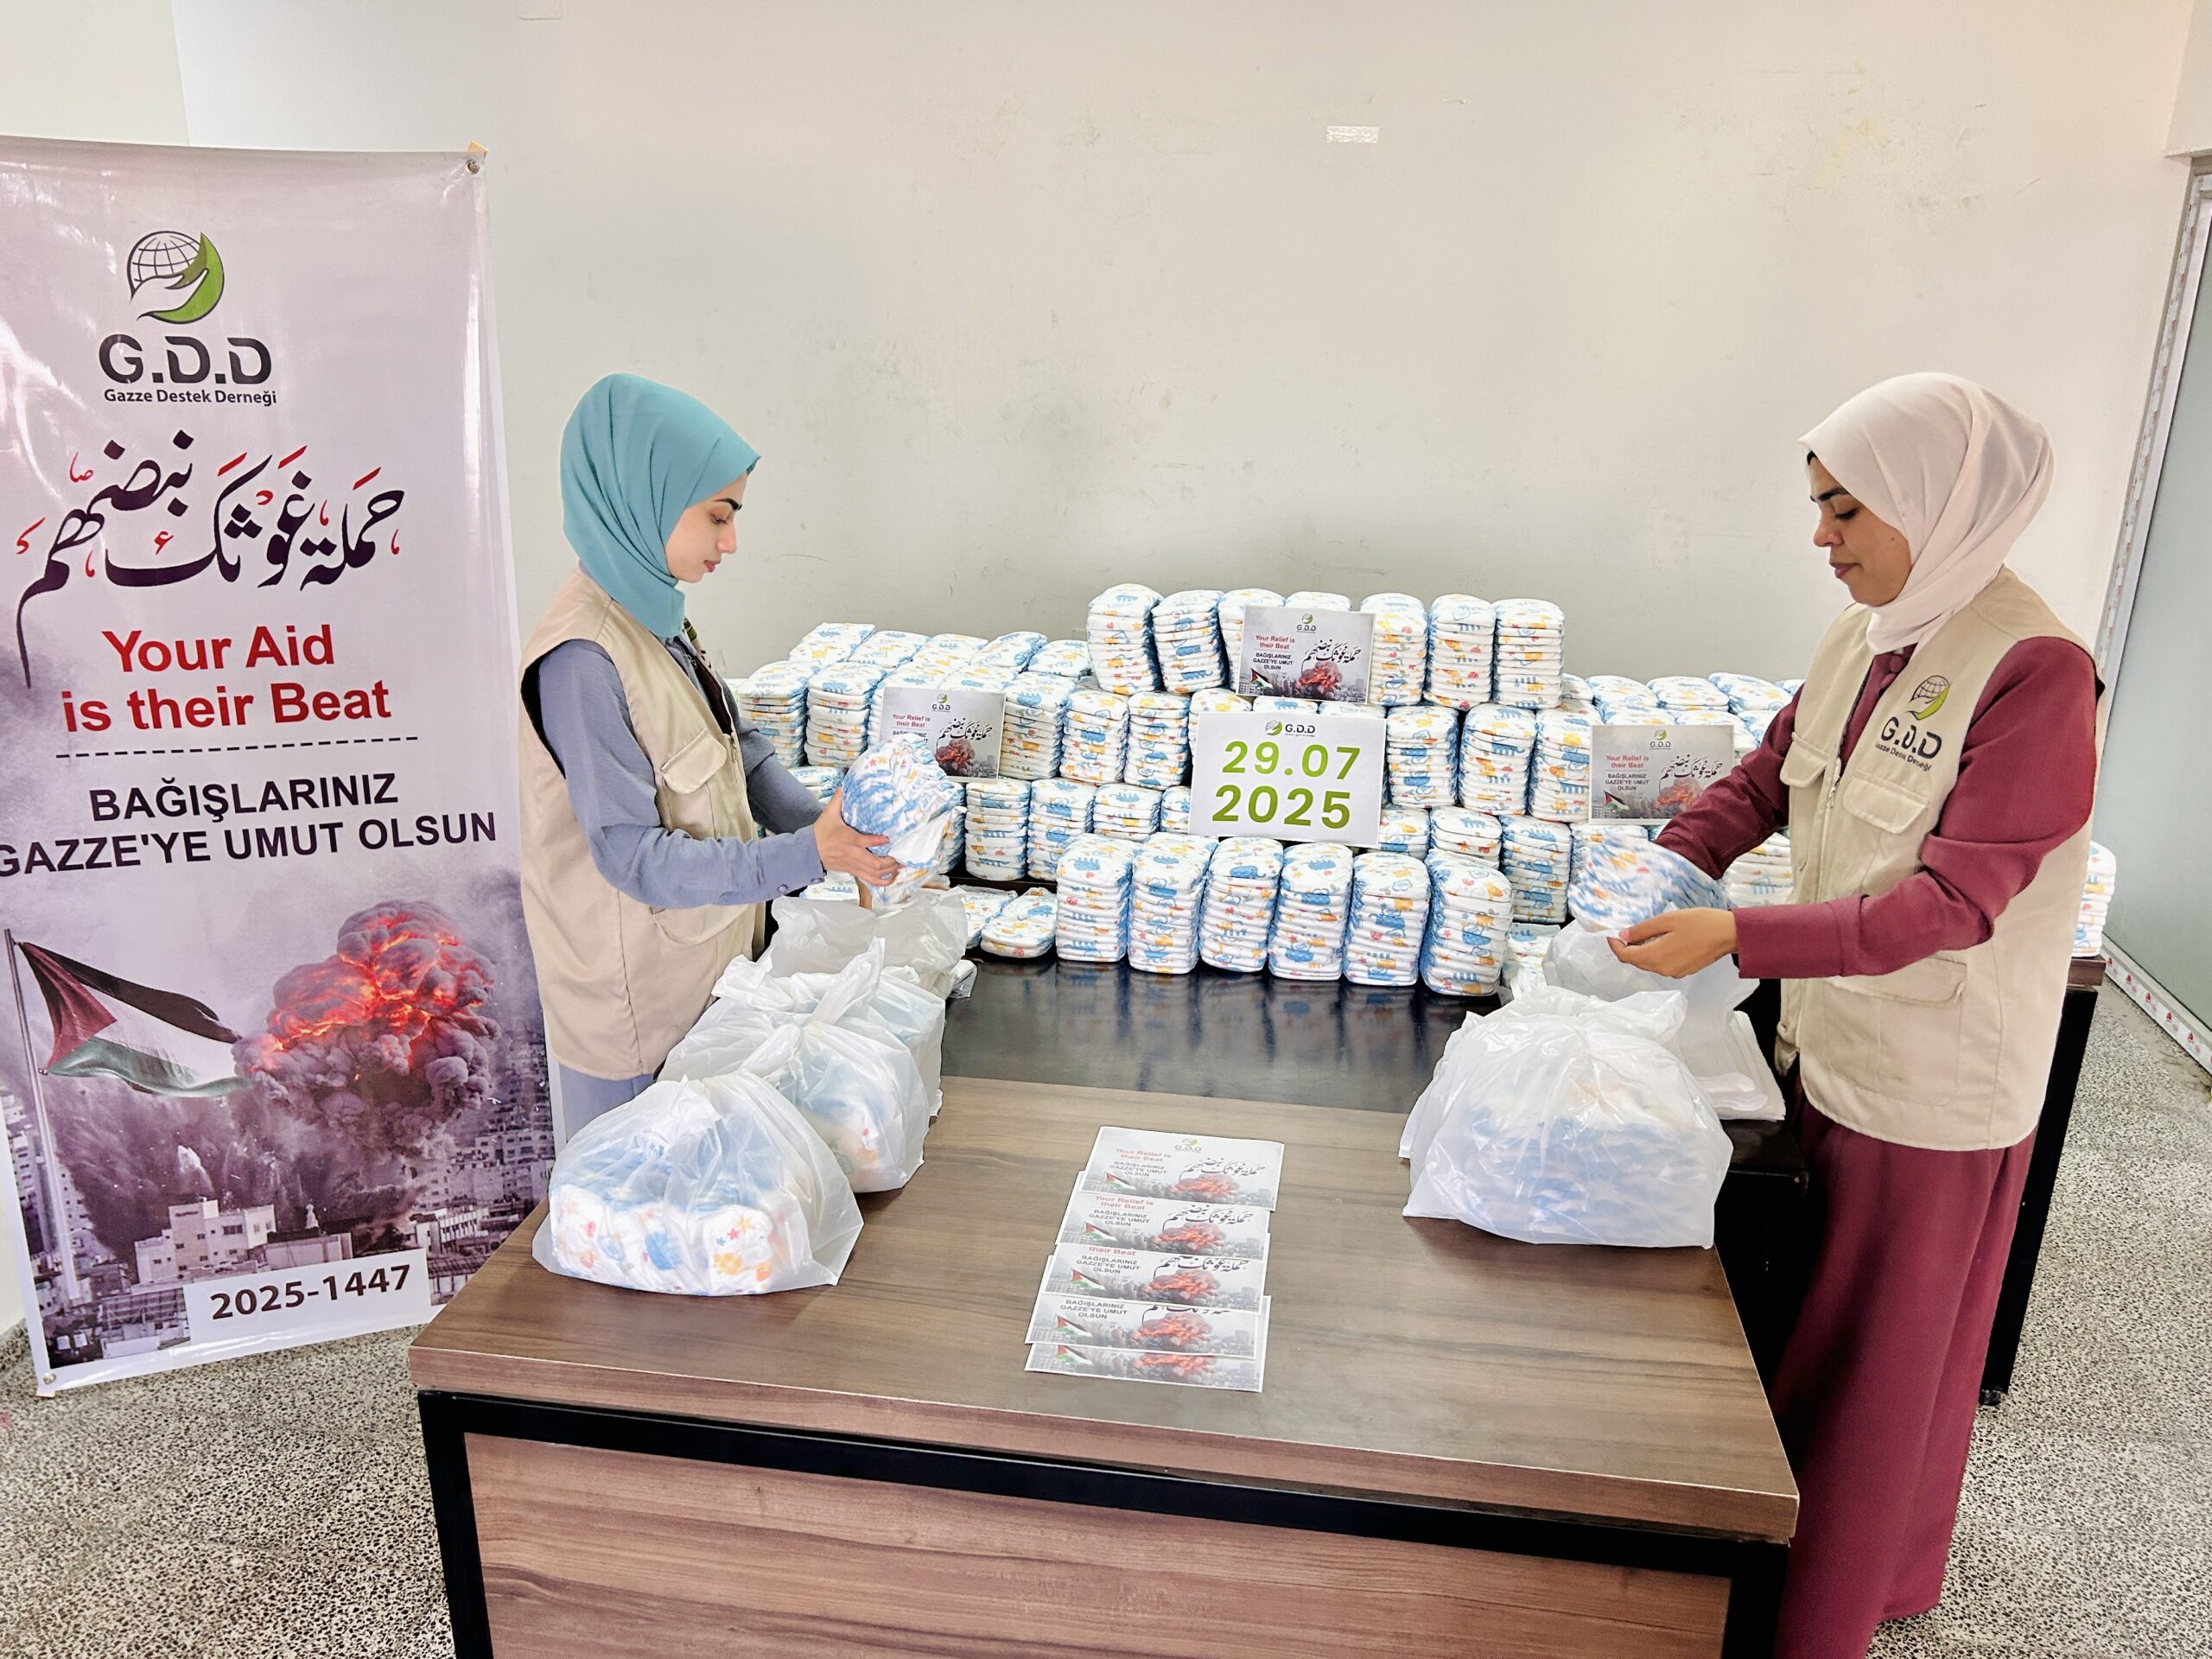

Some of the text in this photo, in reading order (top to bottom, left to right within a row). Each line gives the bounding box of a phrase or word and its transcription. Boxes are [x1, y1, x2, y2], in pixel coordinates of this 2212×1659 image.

[99, 334, 272, 385] G.D.D
[104, 387, 276, 407] Gazze Destek Derneği
[101, 624, 335, 673] Your Aid
[61, 680, 391, 732] is their Beat
[1285, 724, 1316, 734] G.D.D
[1222, 741, 1361, 779] 29.07
[89, 772, 399, 823] BAĞIŞLARINIZ
[1212, 785, 1351, 830] 2025
[0, 811, 497, 877] GAZZE'YE UMUT OLSUN
[209, 1263, 411, 1320] 2025-1447
